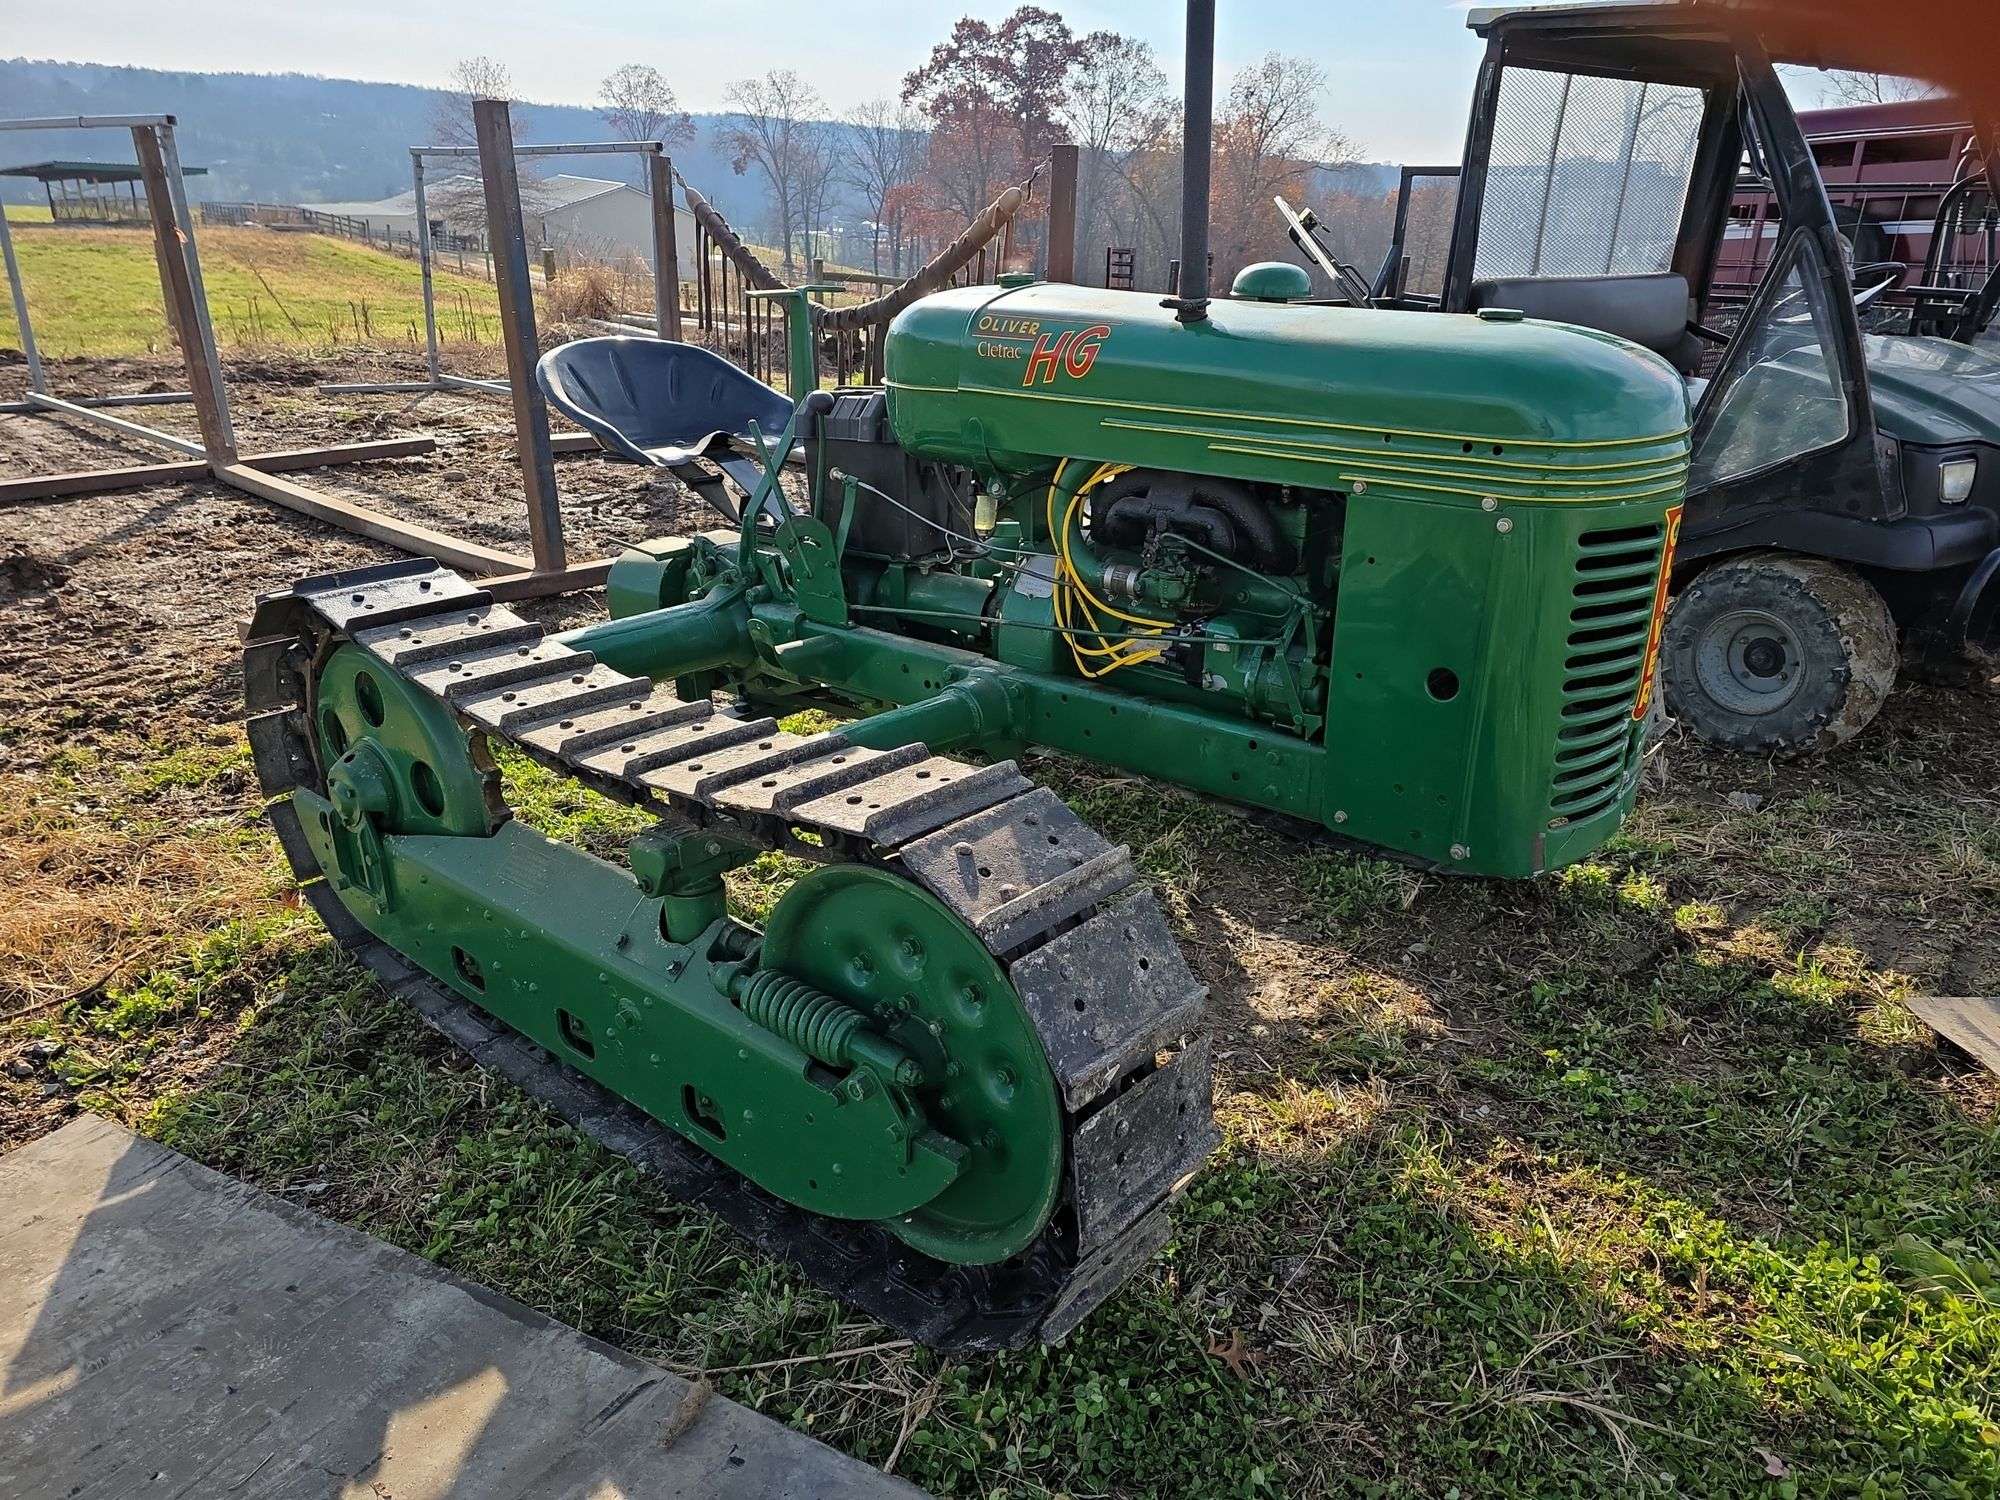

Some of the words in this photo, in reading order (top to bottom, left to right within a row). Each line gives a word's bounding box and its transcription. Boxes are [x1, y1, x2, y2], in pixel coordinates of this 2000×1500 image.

[978, 315, 1041, 335] OLIVER
[977, 341, 1022, 360] Cletrac
[1022, 325, 1111, 387] HG
